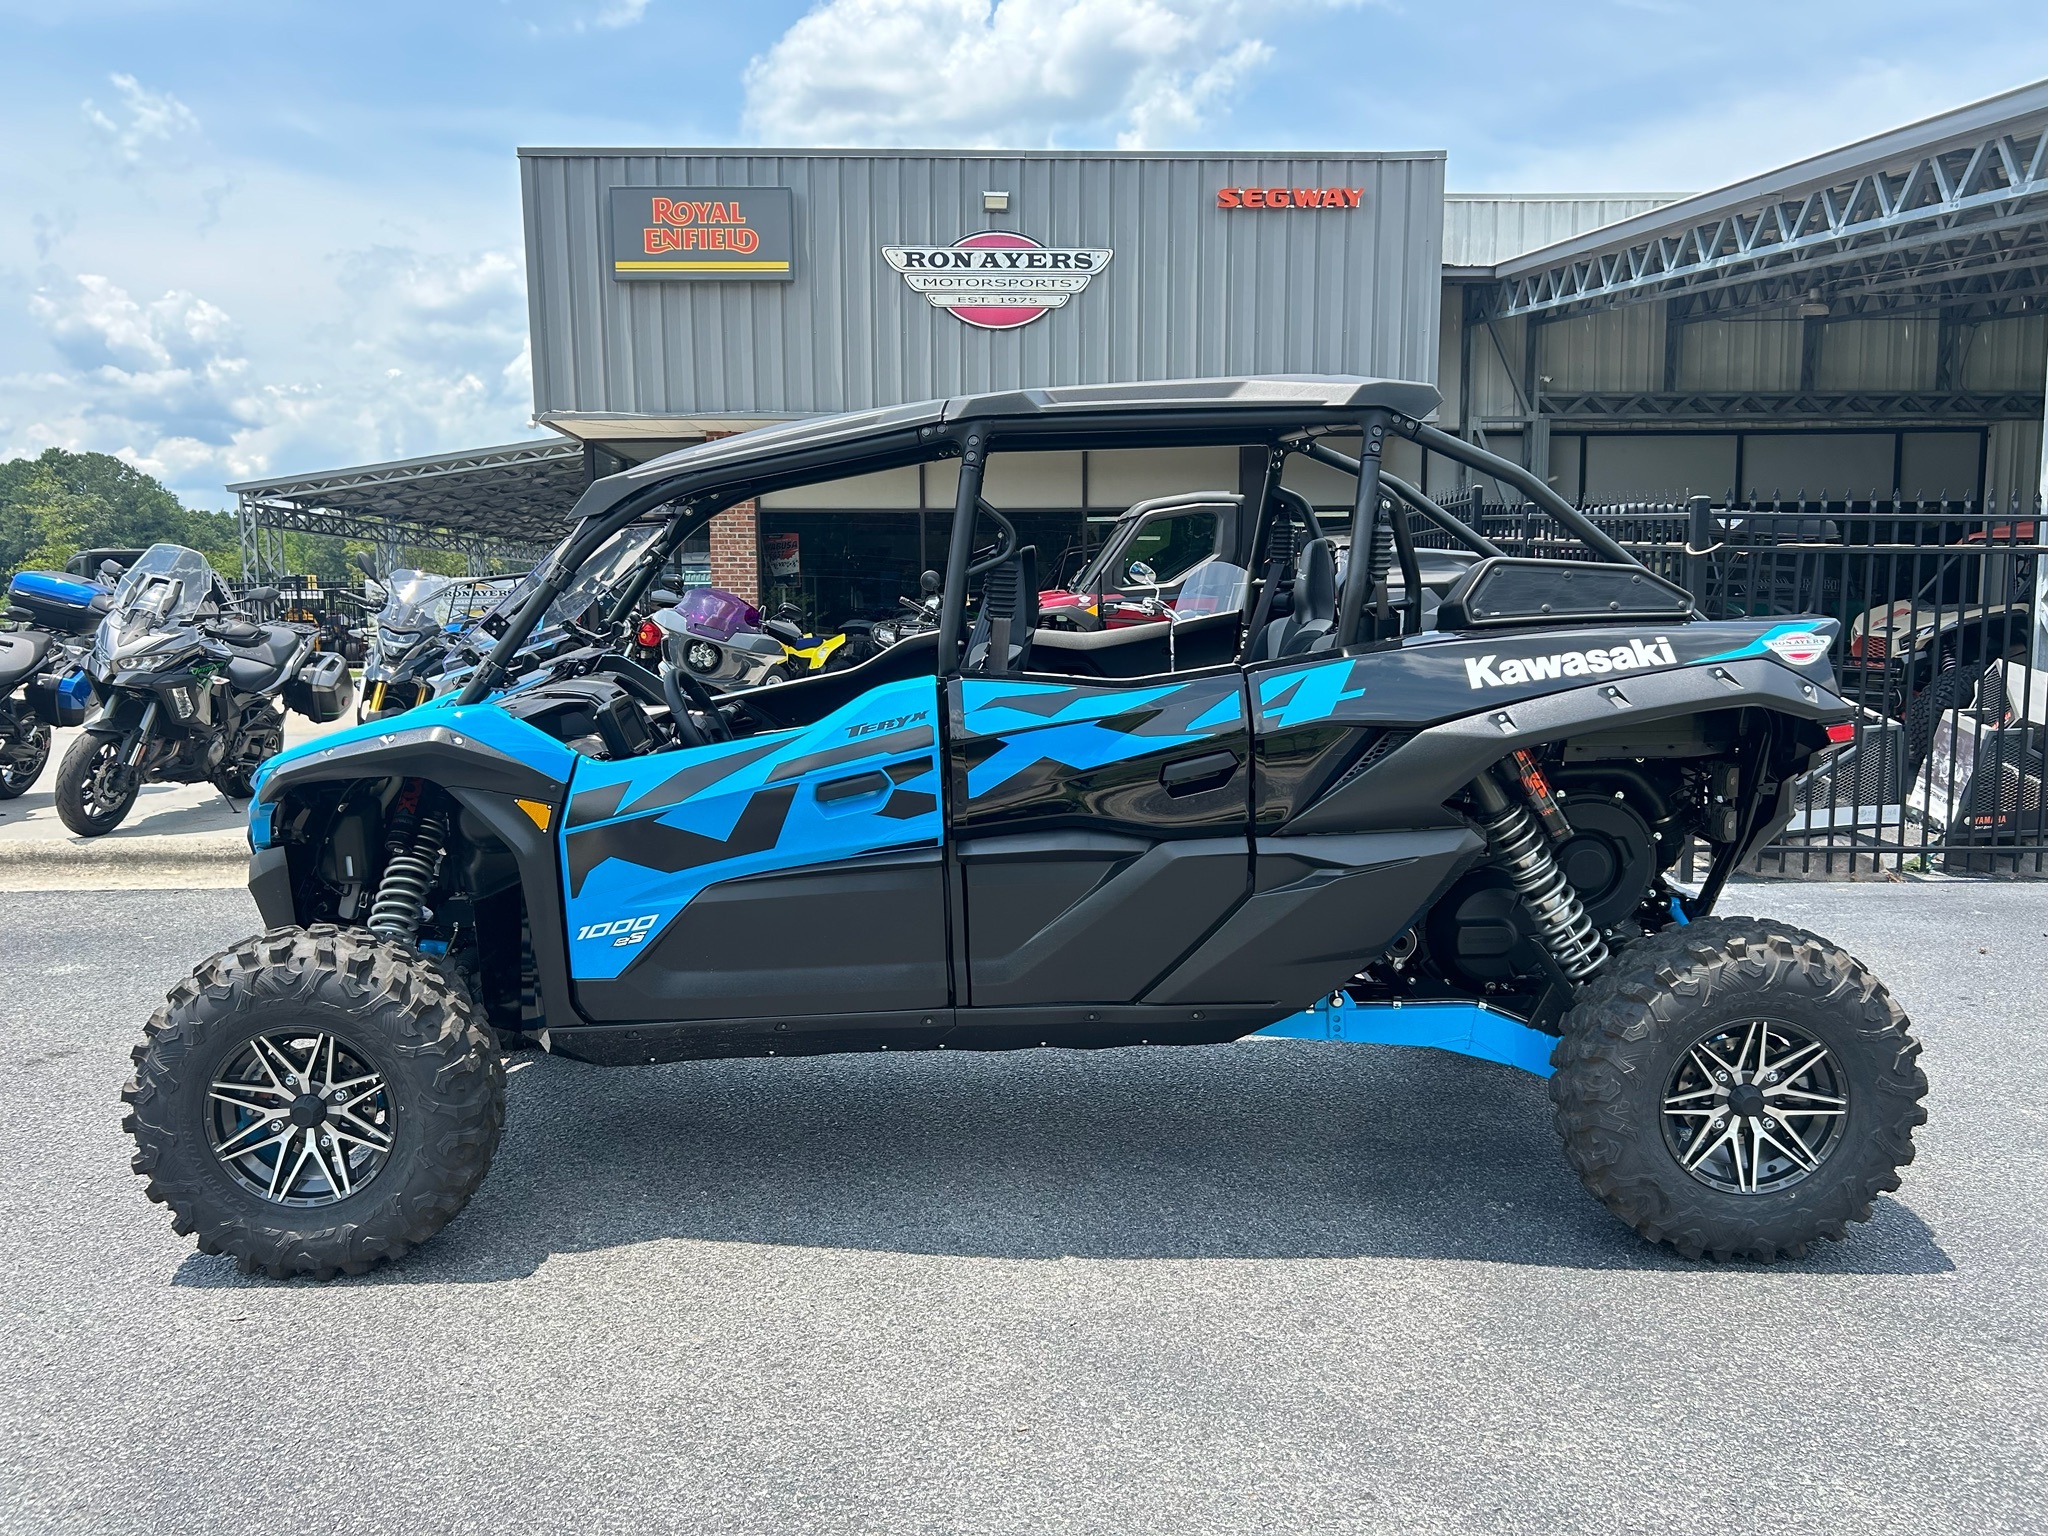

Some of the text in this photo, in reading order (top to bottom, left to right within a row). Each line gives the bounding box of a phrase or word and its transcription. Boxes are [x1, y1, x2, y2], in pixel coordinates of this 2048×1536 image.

[1217, 188, 1365, 208] SEGWAY
[652, 198, 746, 226] ROYAL
[644, 228, 759, 254] ENFIELD
[903, 251, 1094, 270] RON AYERS
[923, 278, 1072, 288] MOTORSPORTS
[957, 296, 1038, 304] EST. 1975
[1464, 636, 1678, 690] Kawasaki
[577, 914, 660, 940] 1000
